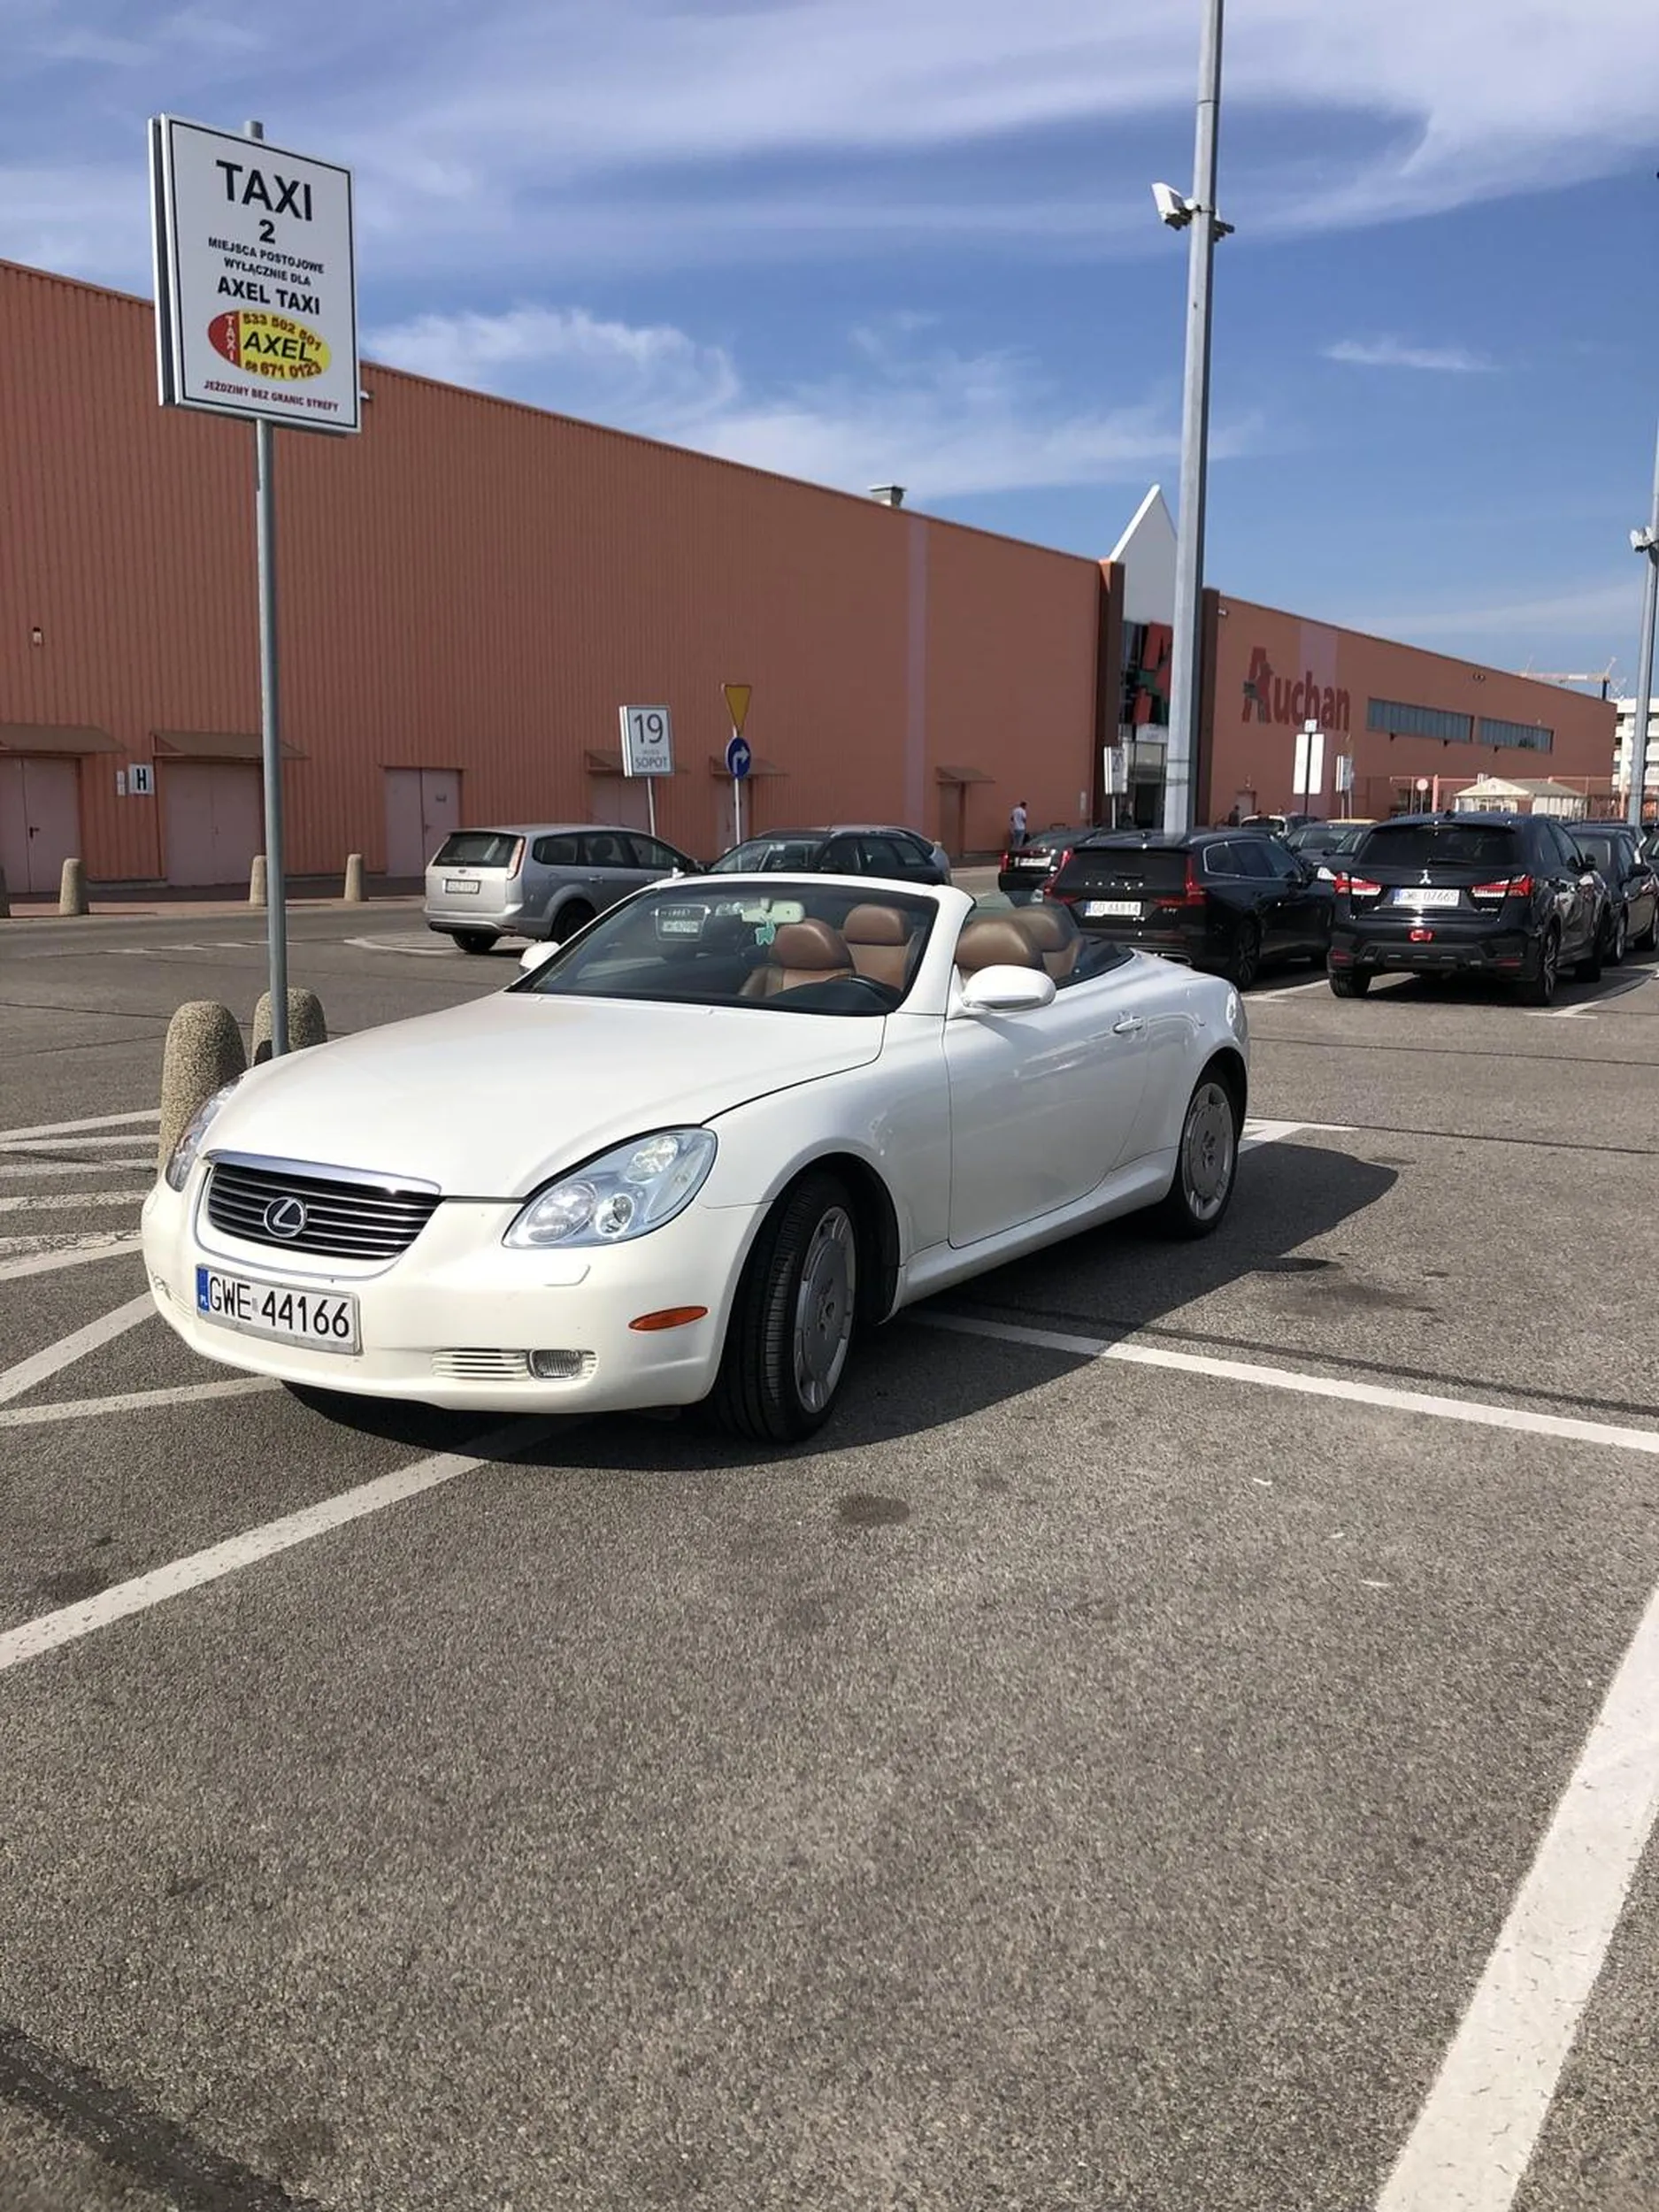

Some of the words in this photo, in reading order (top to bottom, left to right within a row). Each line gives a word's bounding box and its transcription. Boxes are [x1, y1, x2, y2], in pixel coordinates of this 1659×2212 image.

[216, 159, 312, 221] TAXI
[259, 219, 275, 244] 2
[208, 237, 257, 258] MIEJSCA
[259, 250, 324, 274] POSTOJOWE
[224, 257, 288, 281] WYŁĄCZNIE
[290, 273, 311, 287] DLA
[218, 275, 271, 304] AXEL
[276, 288, 319, 315] TAXI
[225, 314, 235, 361] TAXI
[243, 330, 312, 363] AXEL
[251, 388, 269, 401] BEZ
[271, 392, 304, 406] GRANIC
[306, 397, 339, 413] STREFY
[1241, 646, 1350, 732] Auchan
[634, 713, 663, 744] 19
[136, 768, 147, 791] H
[635, 757, 667, 770] SOPOT
[209, 1277, 251, 1320] GWE
[261, 1291, 349, 1337] 44166
